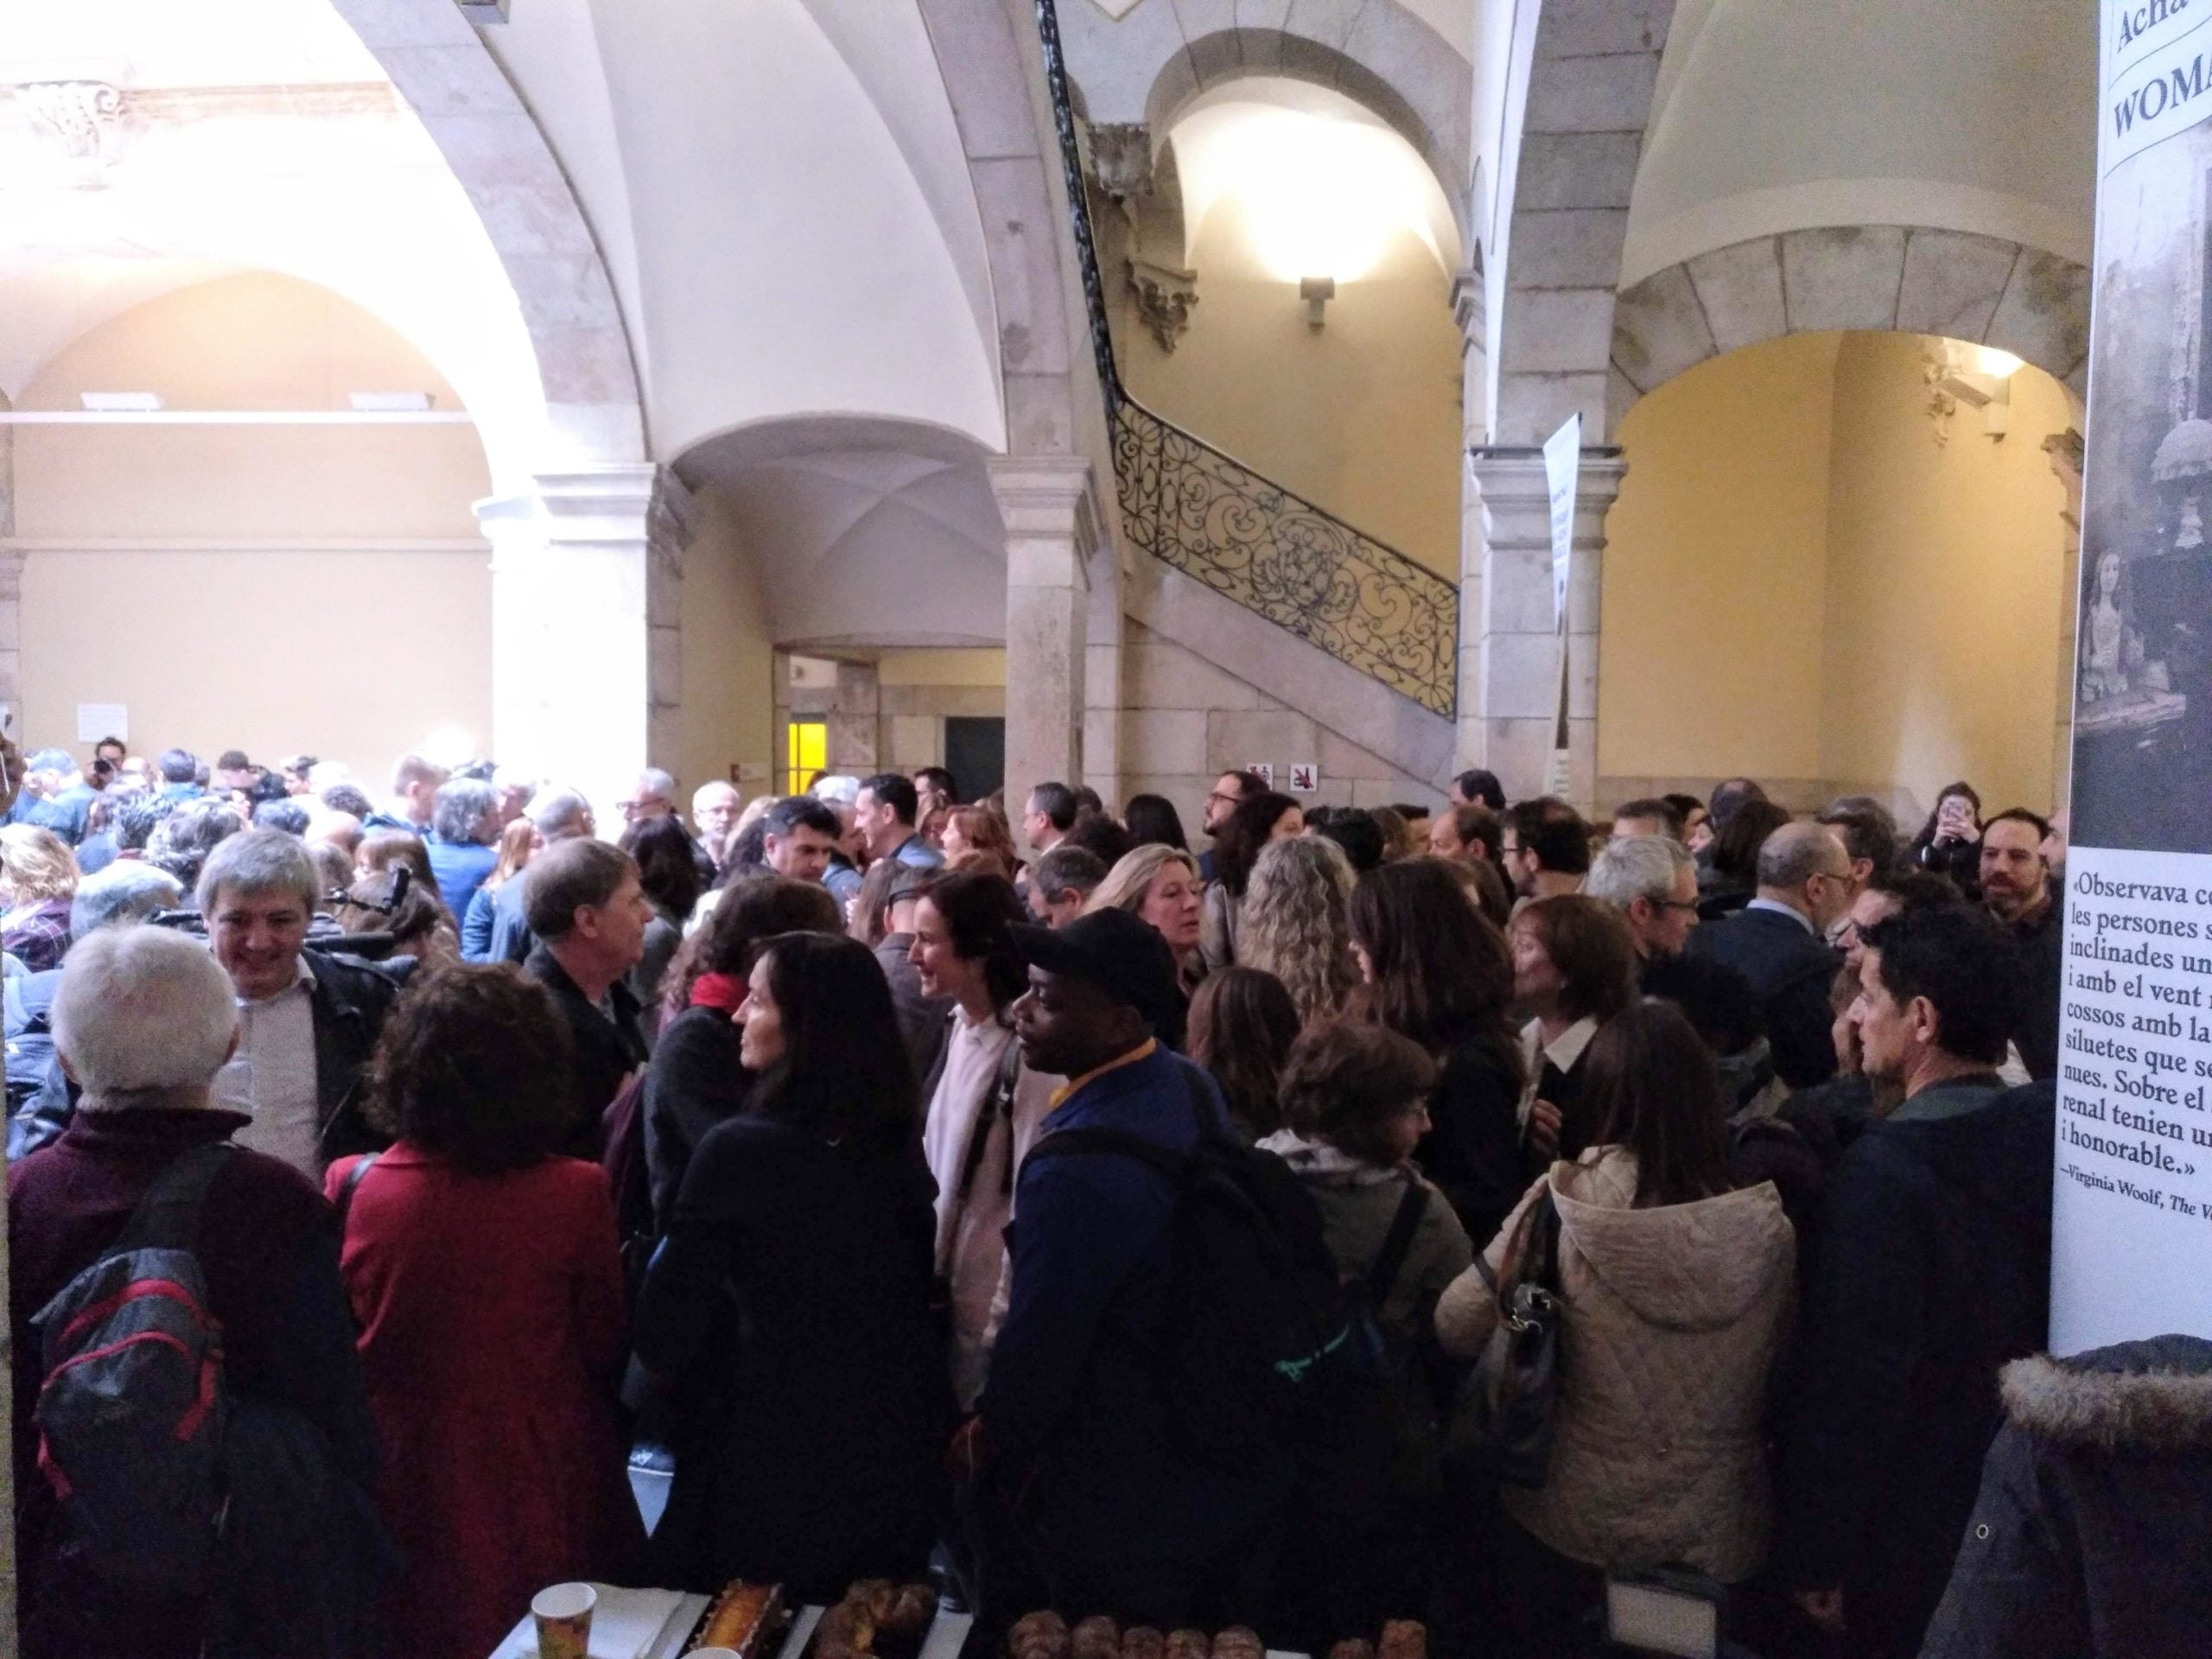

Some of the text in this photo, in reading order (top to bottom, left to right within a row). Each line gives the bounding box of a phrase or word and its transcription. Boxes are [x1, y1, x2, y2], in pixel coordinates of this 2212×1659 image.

[2074, 871, 2212, 906] «Observava c
[2071, 902, 2091, 926] les
[2097, 912, 2198, 938] persones
[2069, 933, 2174, 969] inclinades
[2069, 964, 2073, 986] i
[2076, 969, 2116, 994] amb
[2123, 974, 2143, 998] el
[2150, 984, 2202, 1007] vent
[2067, 1001, 2211, 1043] cossos amb la
[2065, 1027, 2138, 1064] siluetes
[2145, 1050, 2187, 1075] que
[2063, 1064, 2204, 1111] nues. Sobre el
[2063, 1093, 2106, 1122] renal
[2112, 1104, 2184, 1141] tenien
[2062, 1119, 2196, 1175] i honorable.»
[2118, 1179, 2164, 1210] Woolf,
[2170, 1194, 2196, 1216] The
[2202, 1203, 2212, 1220] V
